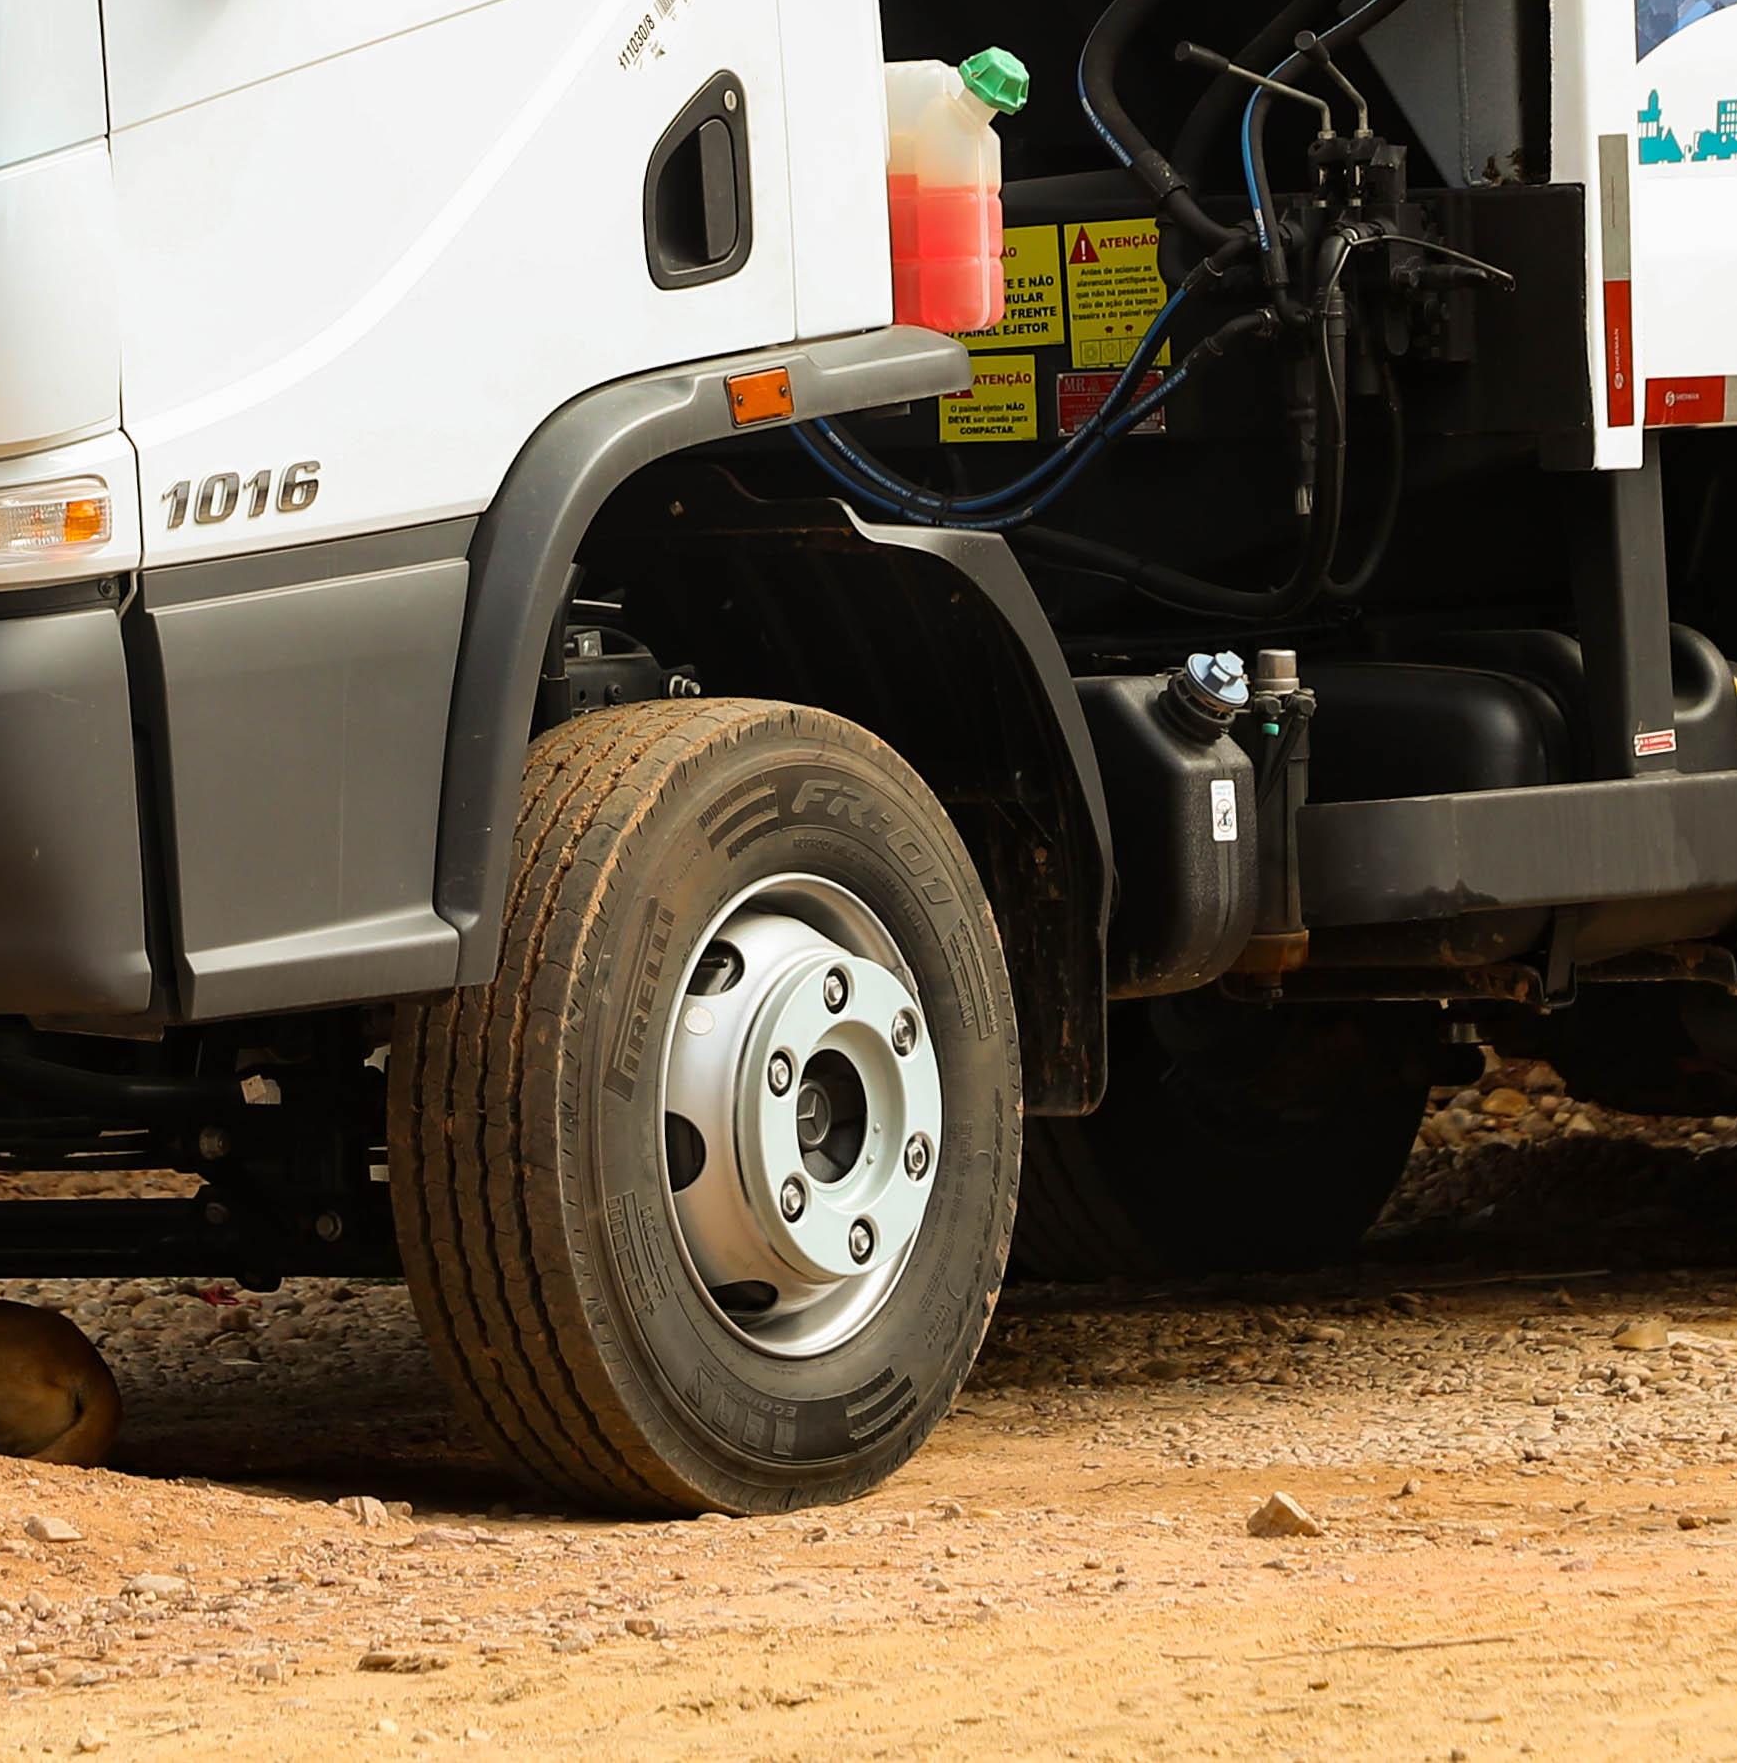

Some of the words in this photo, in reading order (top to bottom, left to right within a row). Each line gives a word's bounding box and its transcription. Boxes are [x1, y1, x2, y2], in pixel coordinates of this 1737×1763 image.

[1099, 234, 1159, 249] ATENÇÃO
[1028, 274, 1054, 287] NÃO
[1010, 305, 1057, 319] FRENTE
[1003, 322, 1049, 336] EJETOR
[973, 371, 1032, 387] ATENÇÃO
[1005, 402, 1025, 411] NÃO
[948, 415, 971, 424] DEVE
[161, 459, 322, 530] 1016
